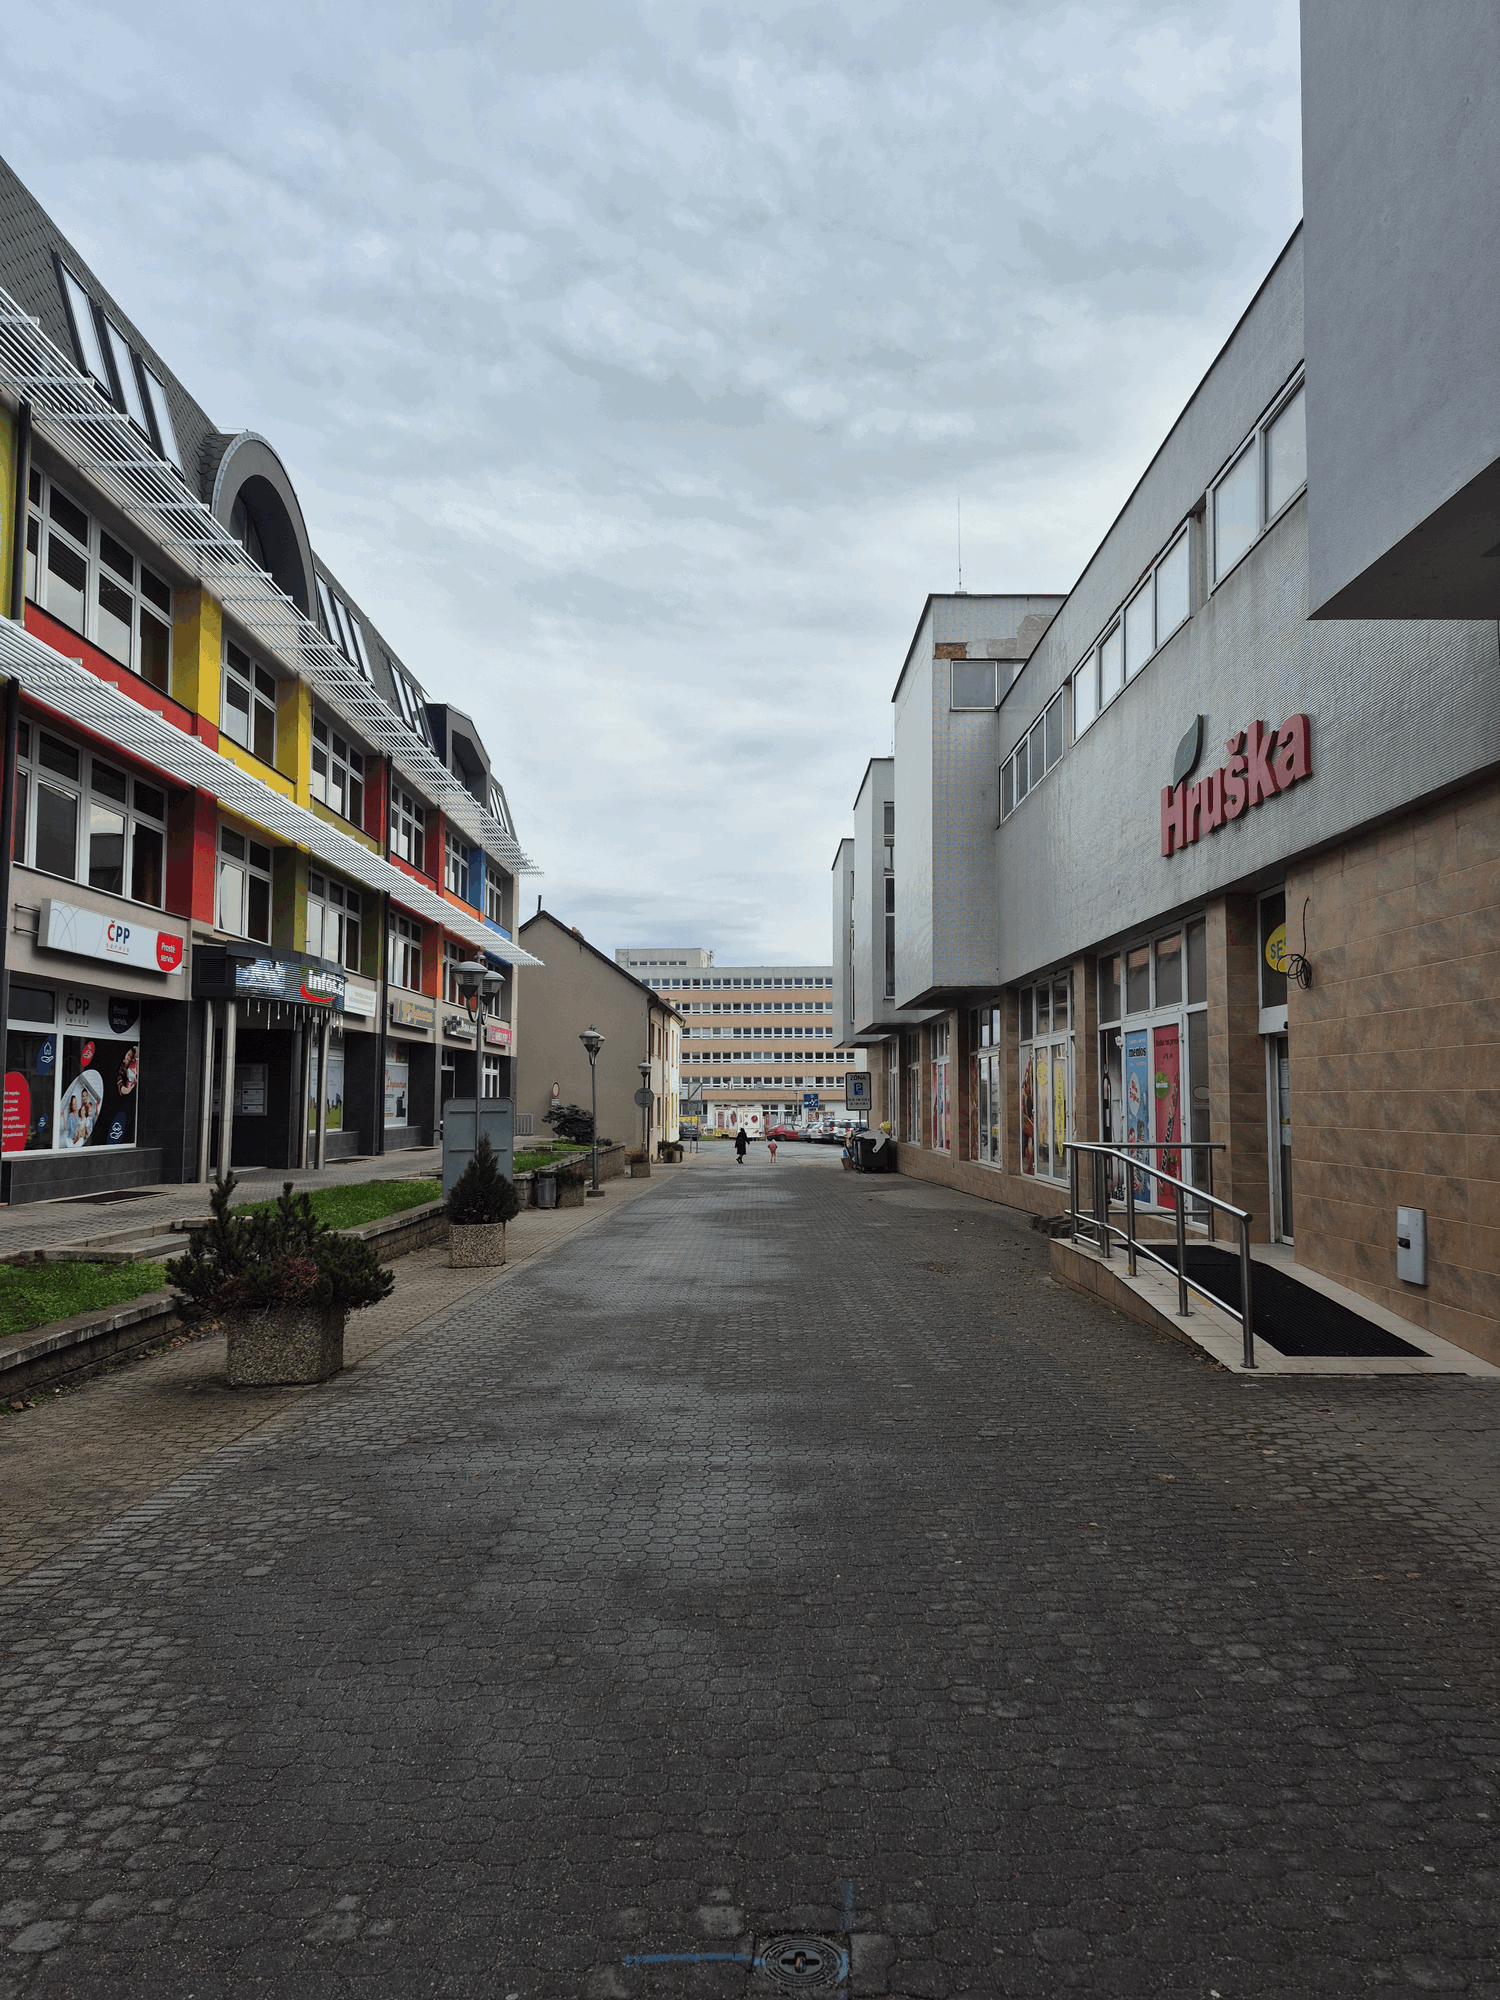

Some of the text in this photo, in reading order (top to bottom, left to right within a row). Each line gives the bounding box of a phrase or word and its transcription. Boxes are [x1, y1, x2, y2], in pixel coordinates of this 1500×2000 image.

[1160, 714, 1311, 858] Hruška
[108, 919, 130, 945] ČPP
[106, 943, 130, 953] servis
[66, 993, 90, 1016] ČPP
